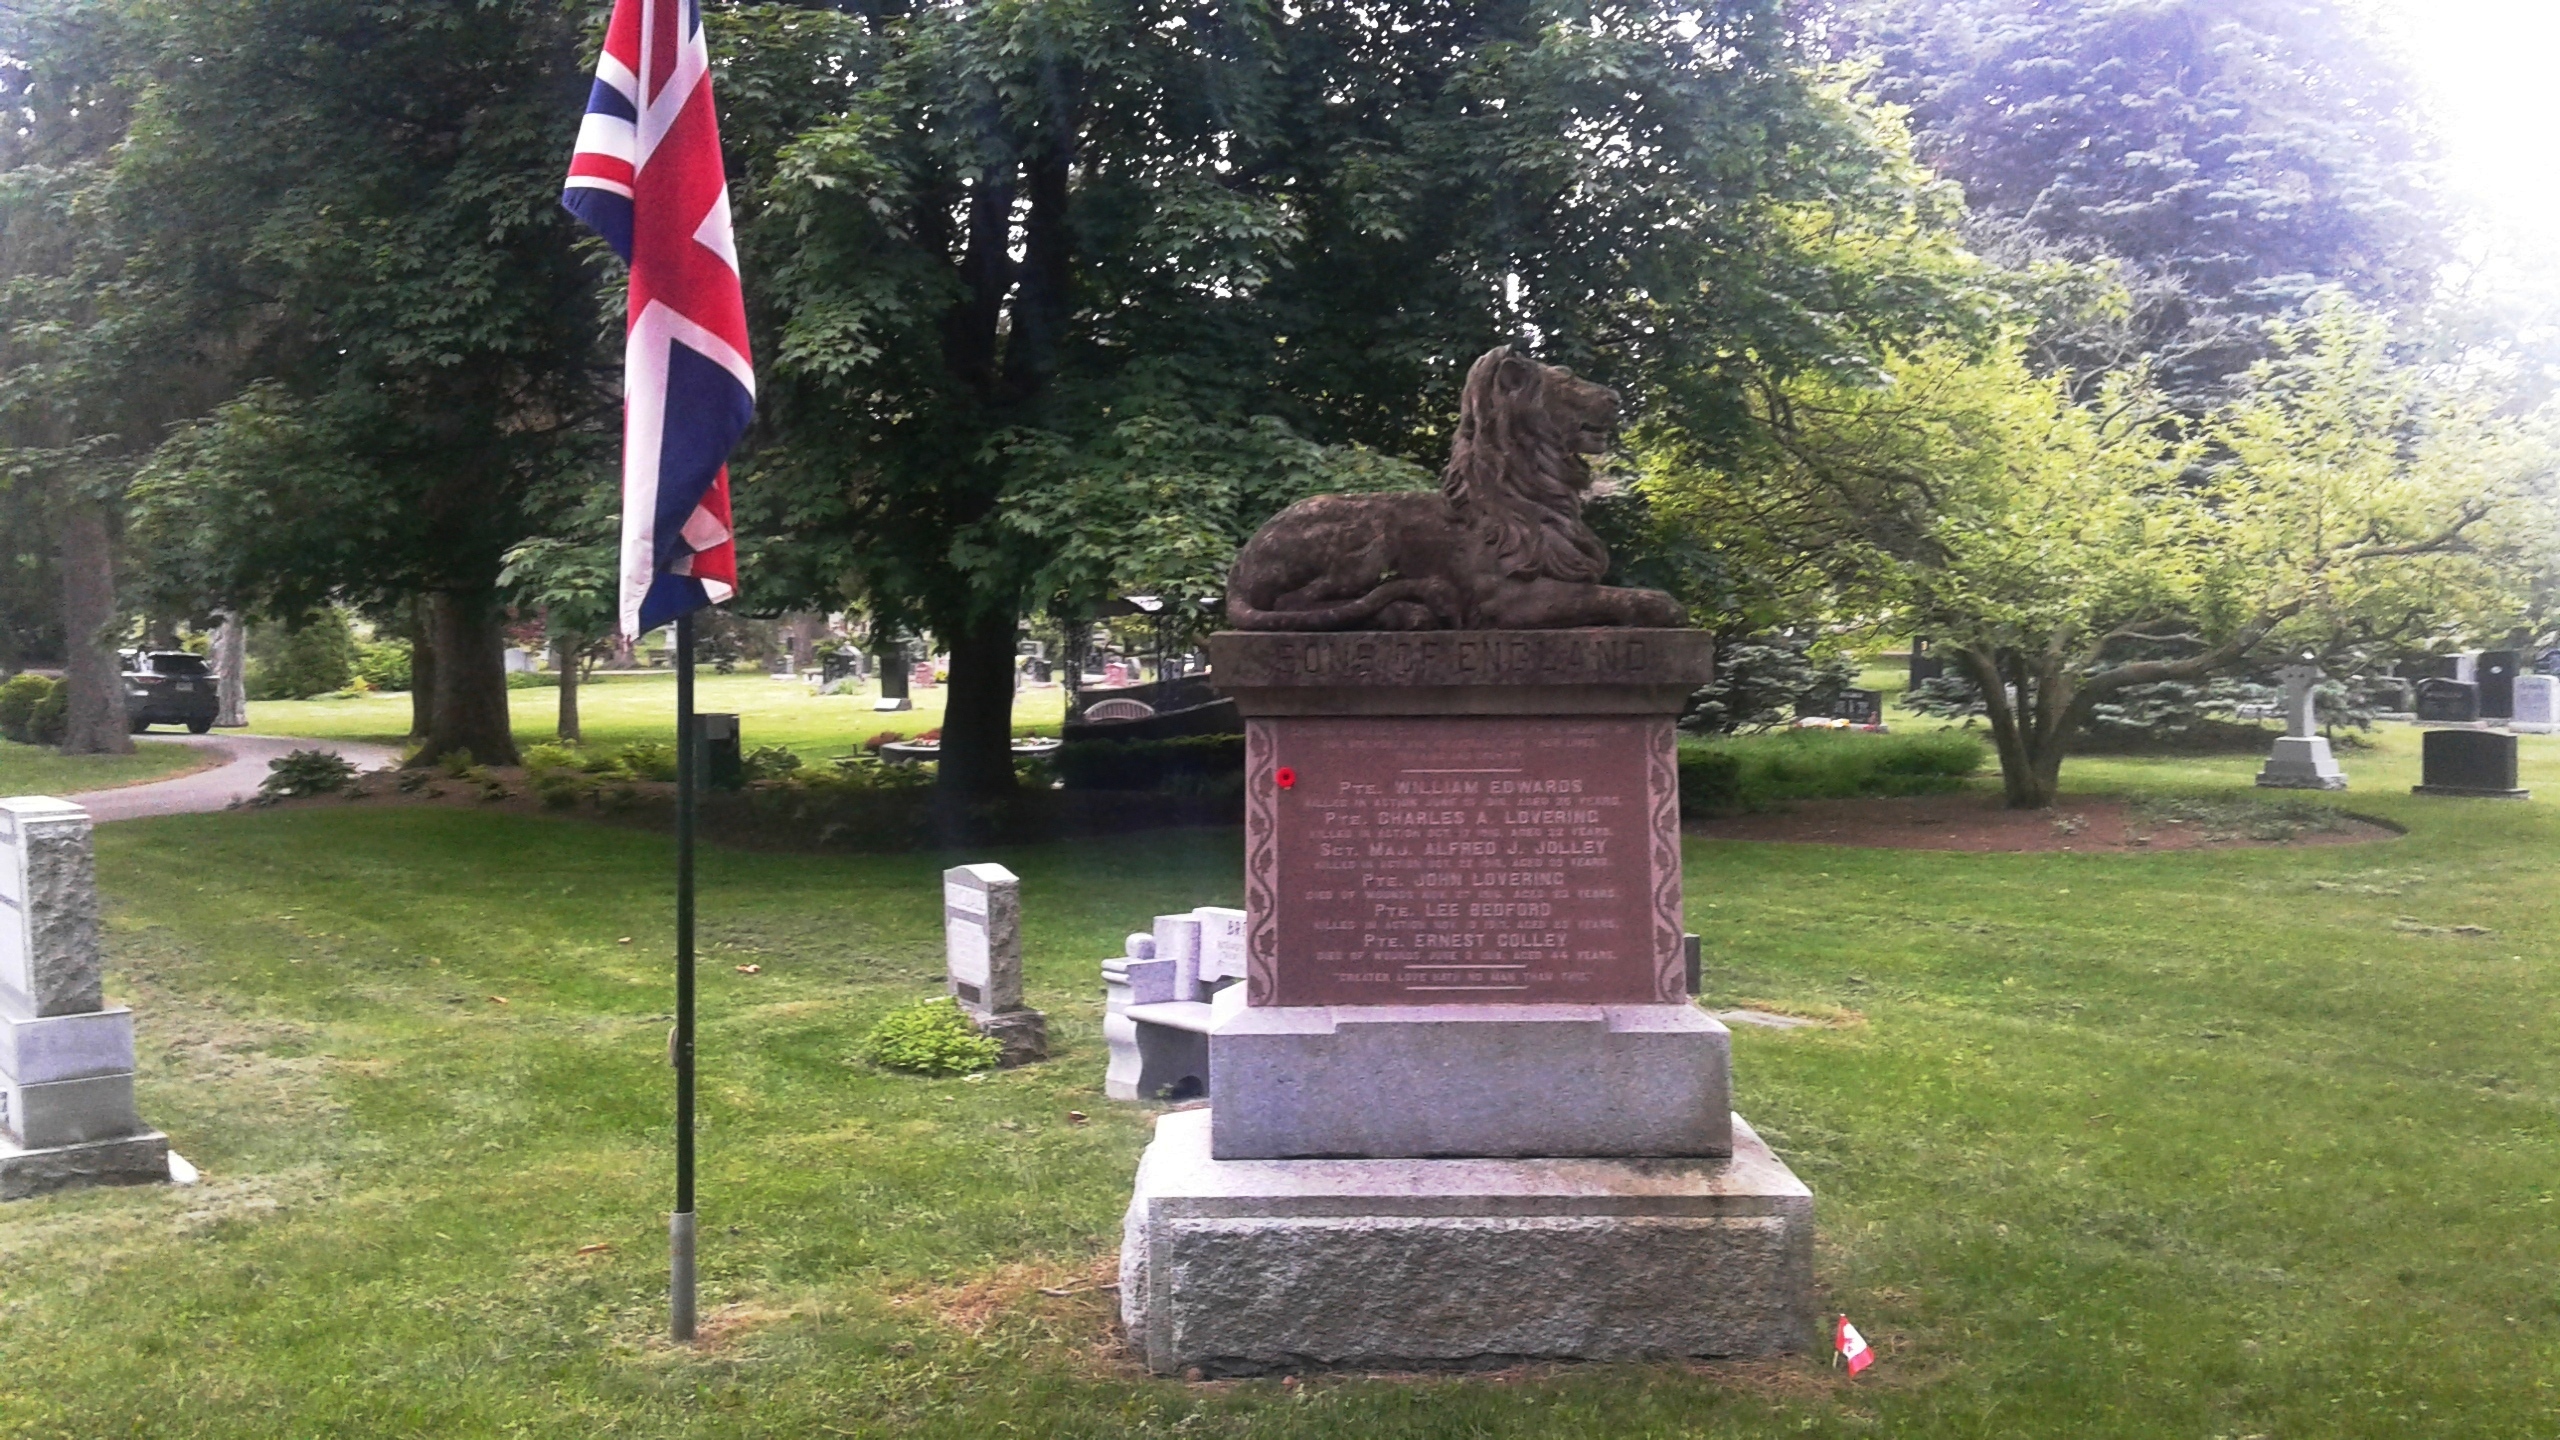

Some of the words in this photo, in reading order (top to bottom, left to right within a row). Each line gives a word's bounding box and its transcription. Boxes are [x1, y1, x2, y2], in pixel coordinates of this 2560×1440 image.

[1276, 643, 1375, 676] SONS
[1396, 642, 1439, 674] OF
[1457, 641, 1646, 672] ENGLAND
[1395, 780, 1479, 794] WILLIAM
[1490, 779, 1582, 794] EDWARDS
[1374, 798, 1418, 807] ACTION
[1378, 811, 1465, 825] CHARLES
[1504, 810, 1599, 824] LOVERING
[1378, 828, 1421, 838] ACTION
[1424, 841, 1496, 855] ALFRED
[1535, 839, 1607, 854] JOLLEY
[1414, 872, 1462, 887] JOHN
[1472, 872, 1564, 886] LOVERING
[1426, 903, 1460, 917] LEE
[1469, 902, 1552, 917] BEDFORD
[1414, 933, 1485, 948] ERNEST
[1497, 933, 1567, 947] COLLEY
